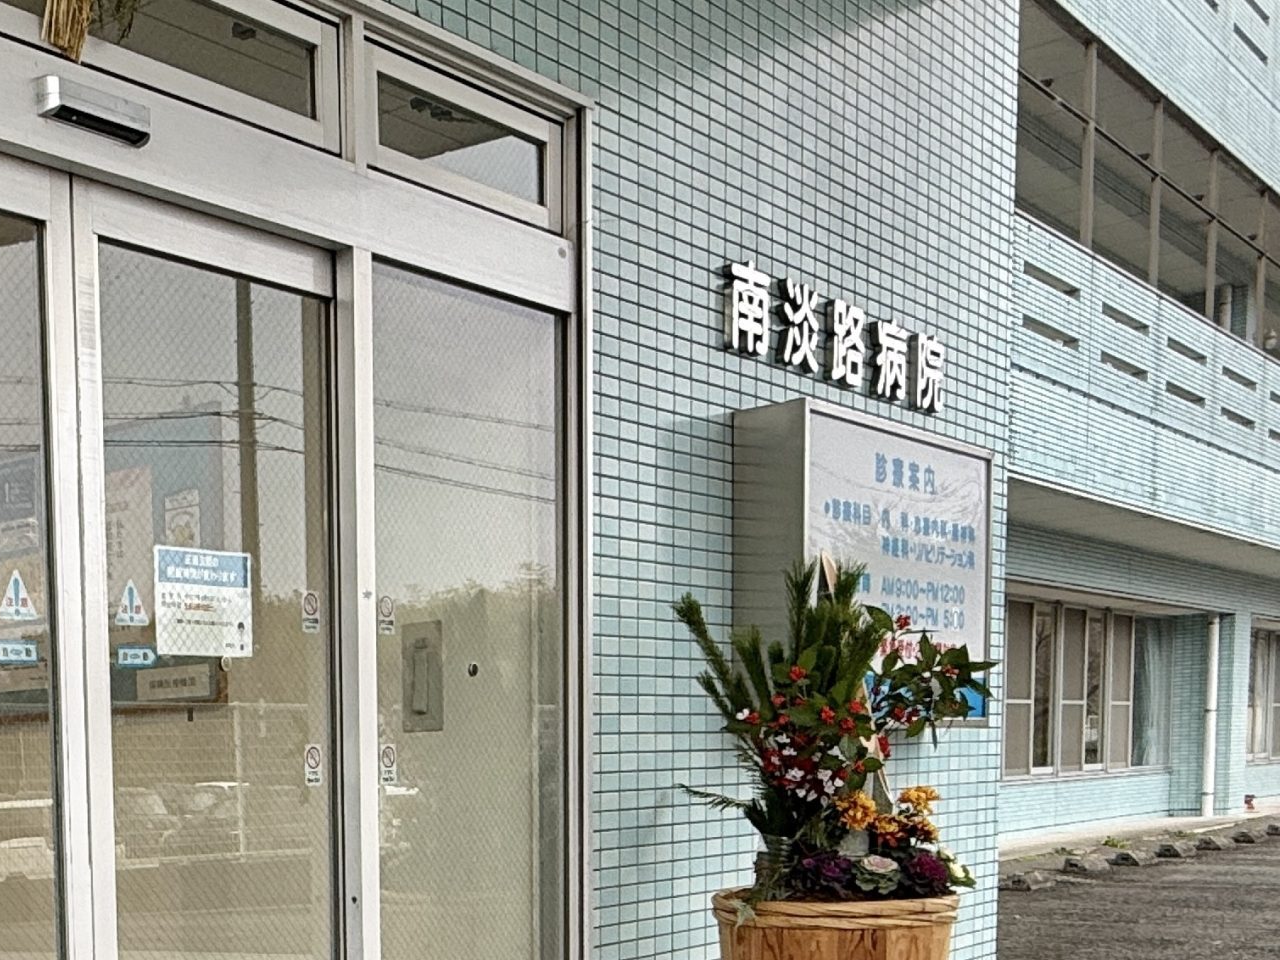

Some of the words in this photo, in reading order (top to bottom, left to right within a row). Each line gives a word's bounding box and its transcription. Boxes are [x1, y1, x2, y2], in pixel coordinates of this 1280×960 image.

[727, 260, 945, 414] 南淡路病院
[875, 452, 935, 495] 診療案内
